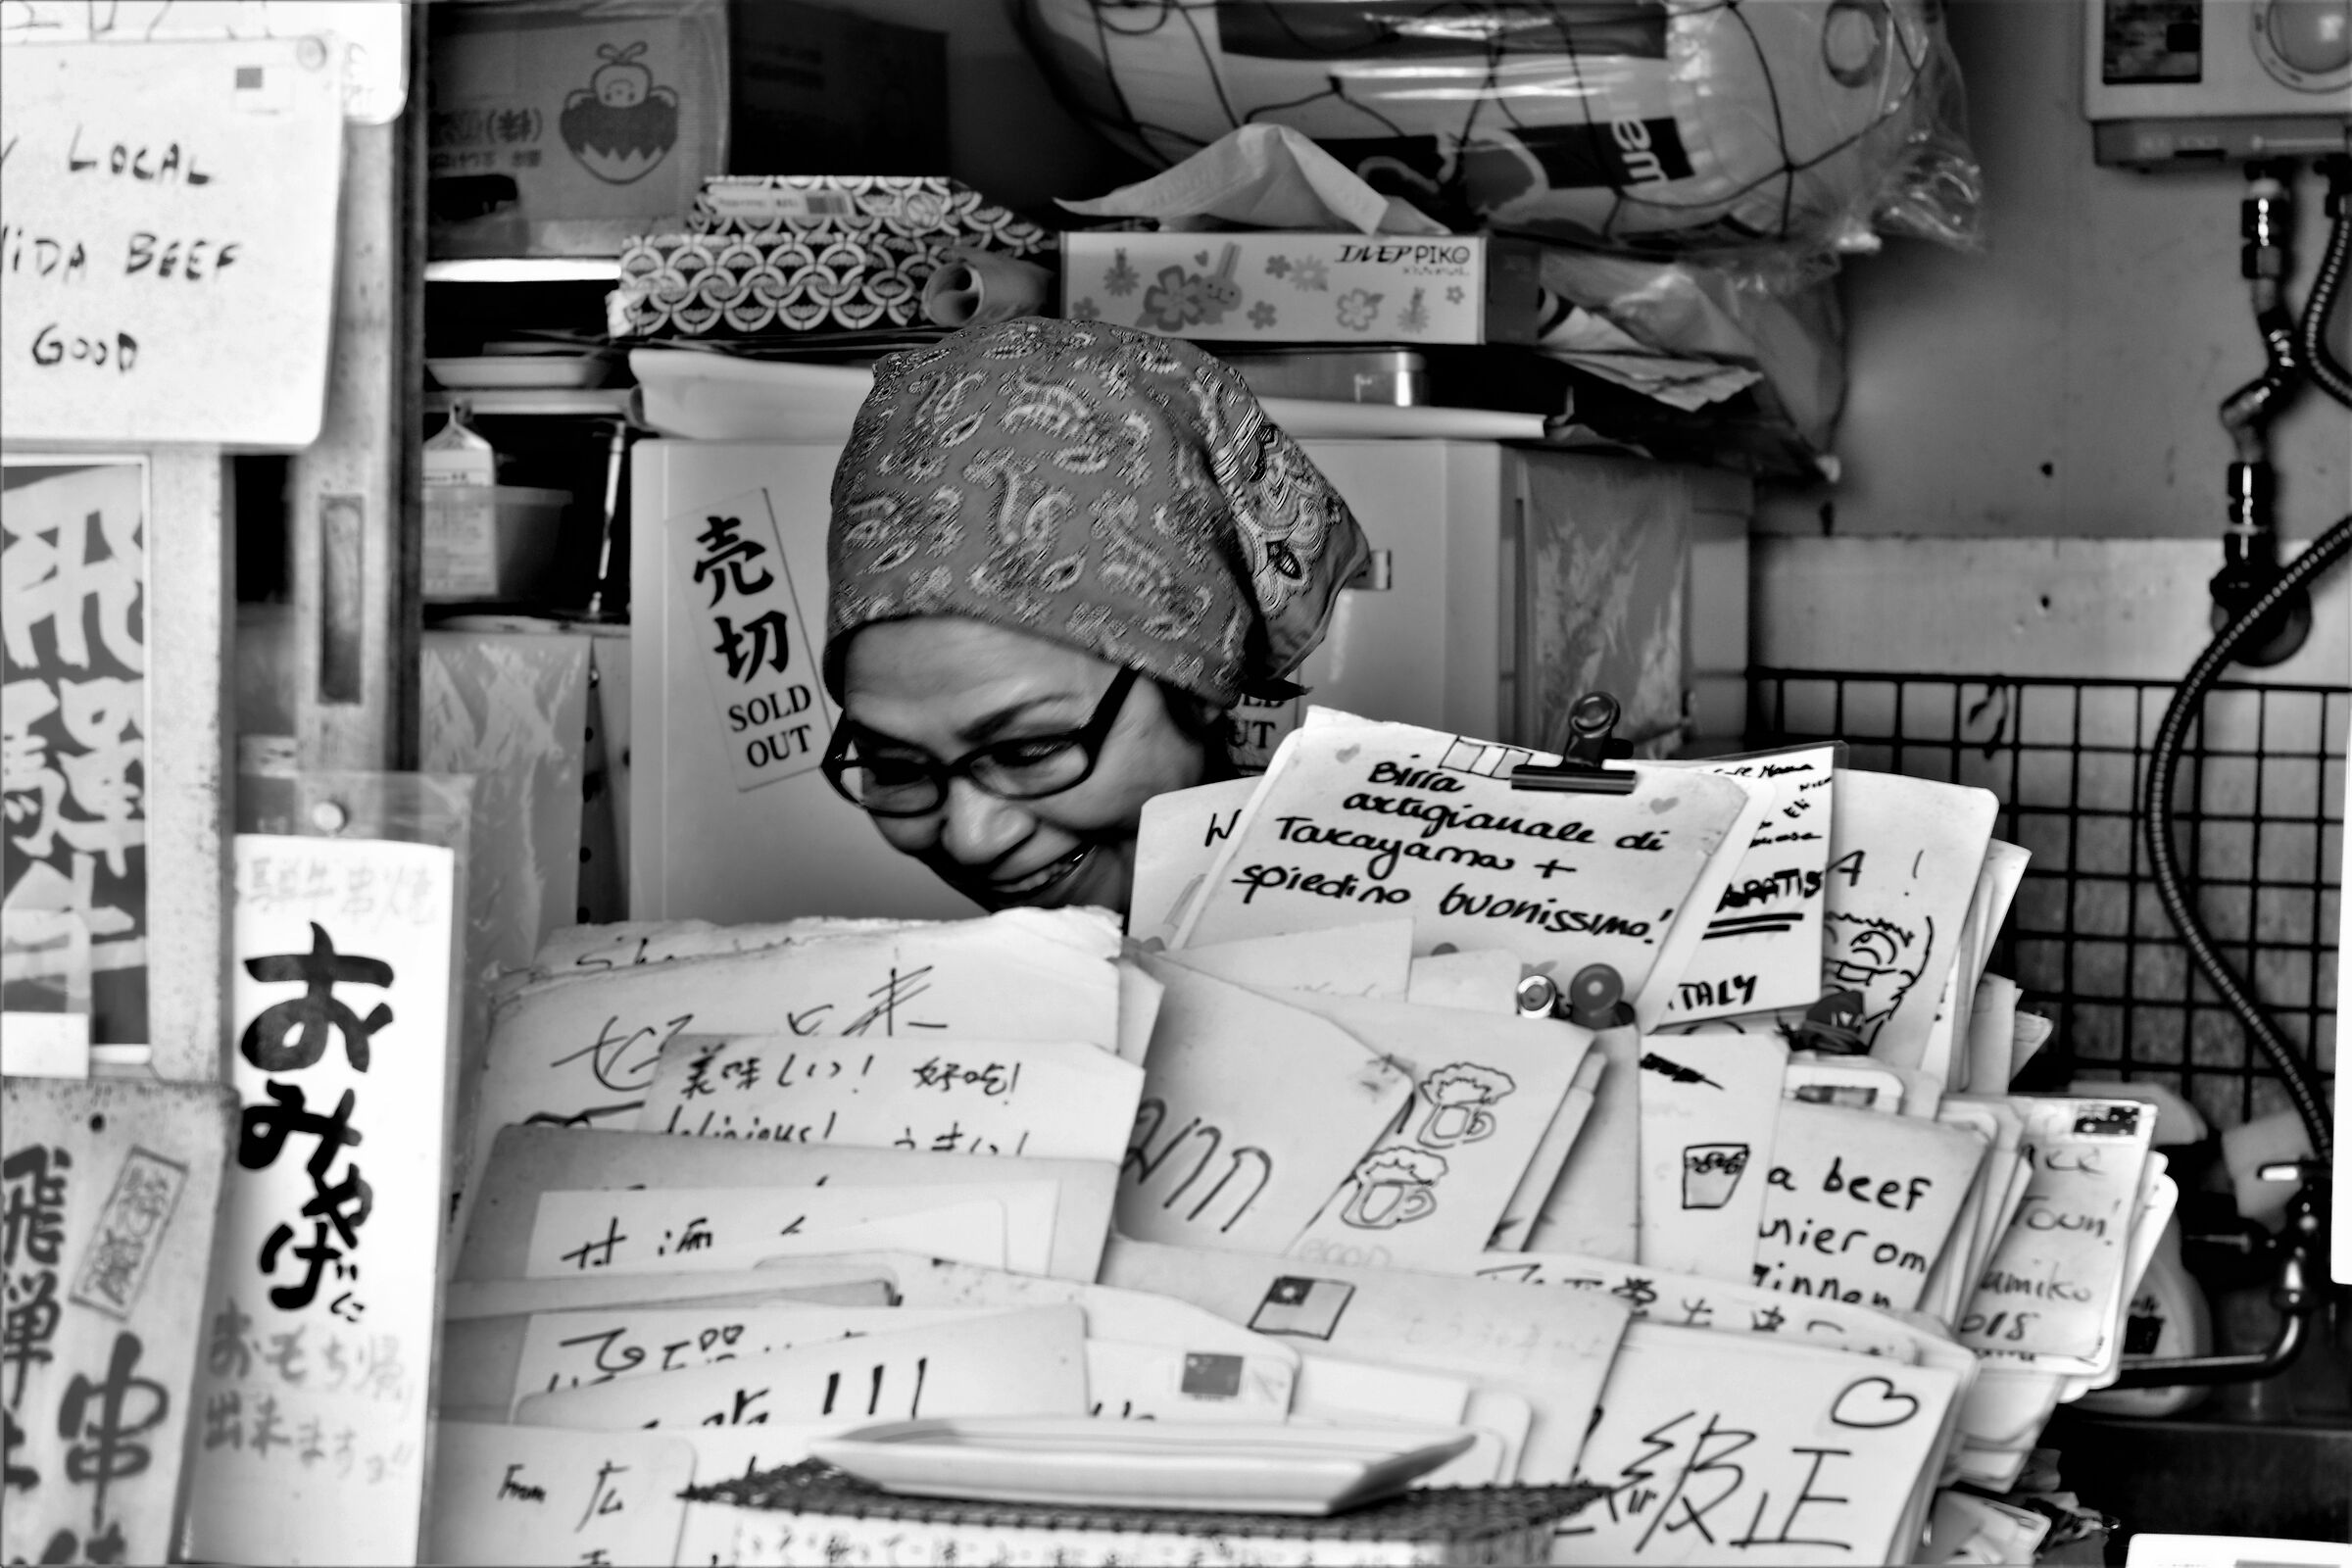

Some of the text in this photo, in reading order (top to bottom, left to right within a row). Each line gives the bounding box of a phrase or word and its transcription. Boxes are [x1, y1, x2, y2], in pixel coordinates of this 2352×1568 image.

[69, 124, 214, 184] LOCAL
[125, 231, 242, 280] BEEF
[1415, 245, 1471, 265] PIKO
[31, 322, 139, 372] GOOD
[693, 514, 789, 684] 売切
[727, 684, 812, 732] SOLD
[746, 723, 812, 768] OUT
[1367, 753, 1467, 793] Birra
[1343, 792, 1671, 852] artigianale di
[1275, 816, 1515, 880] Takayama
[1232, 863, 1675, 945] spiedino buonissimo!
[1668, 975, 1758, 1010] TALY
[1822, 1155, 1933, 1211] beef
